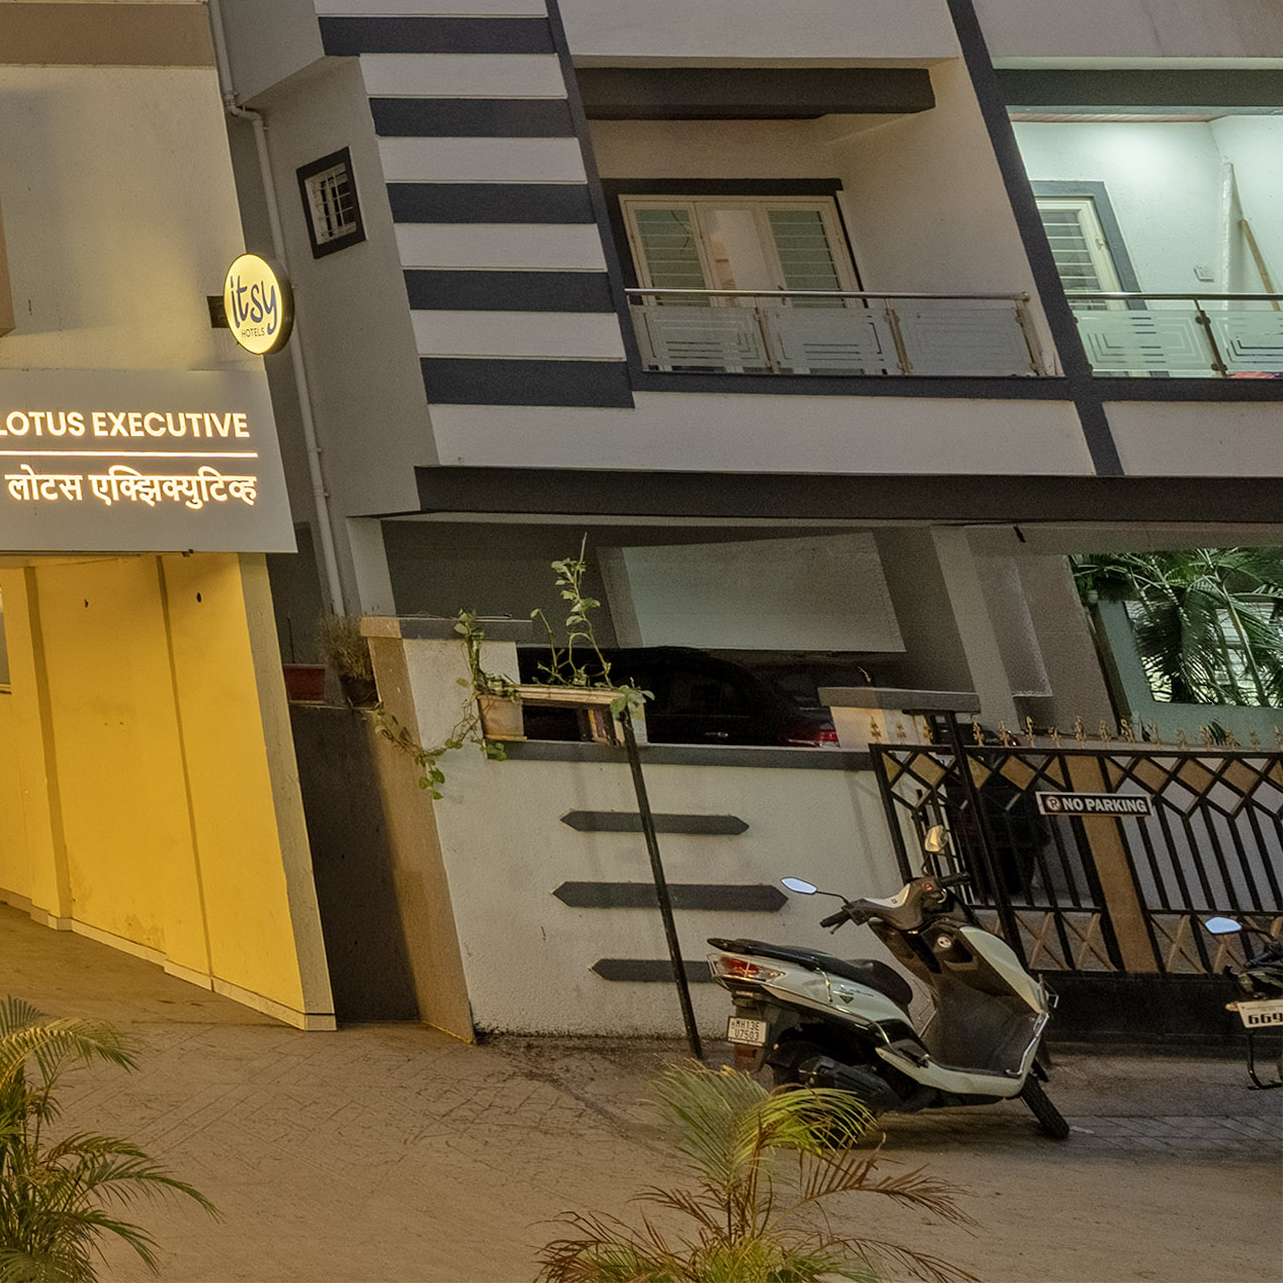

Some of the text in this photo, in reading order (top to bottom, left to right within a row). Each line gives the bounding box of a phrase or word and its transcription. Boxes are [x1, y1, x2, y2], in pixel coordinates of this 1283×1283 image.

[230, 275, 277, 335] itsy
[241, 327, 266, 338] HOTELS
[91, 412, 250, 438] EXECUTIVE
[4, 464, 83, 501] लोटस
[1062, 797, 1148, 813] NO PARKING
